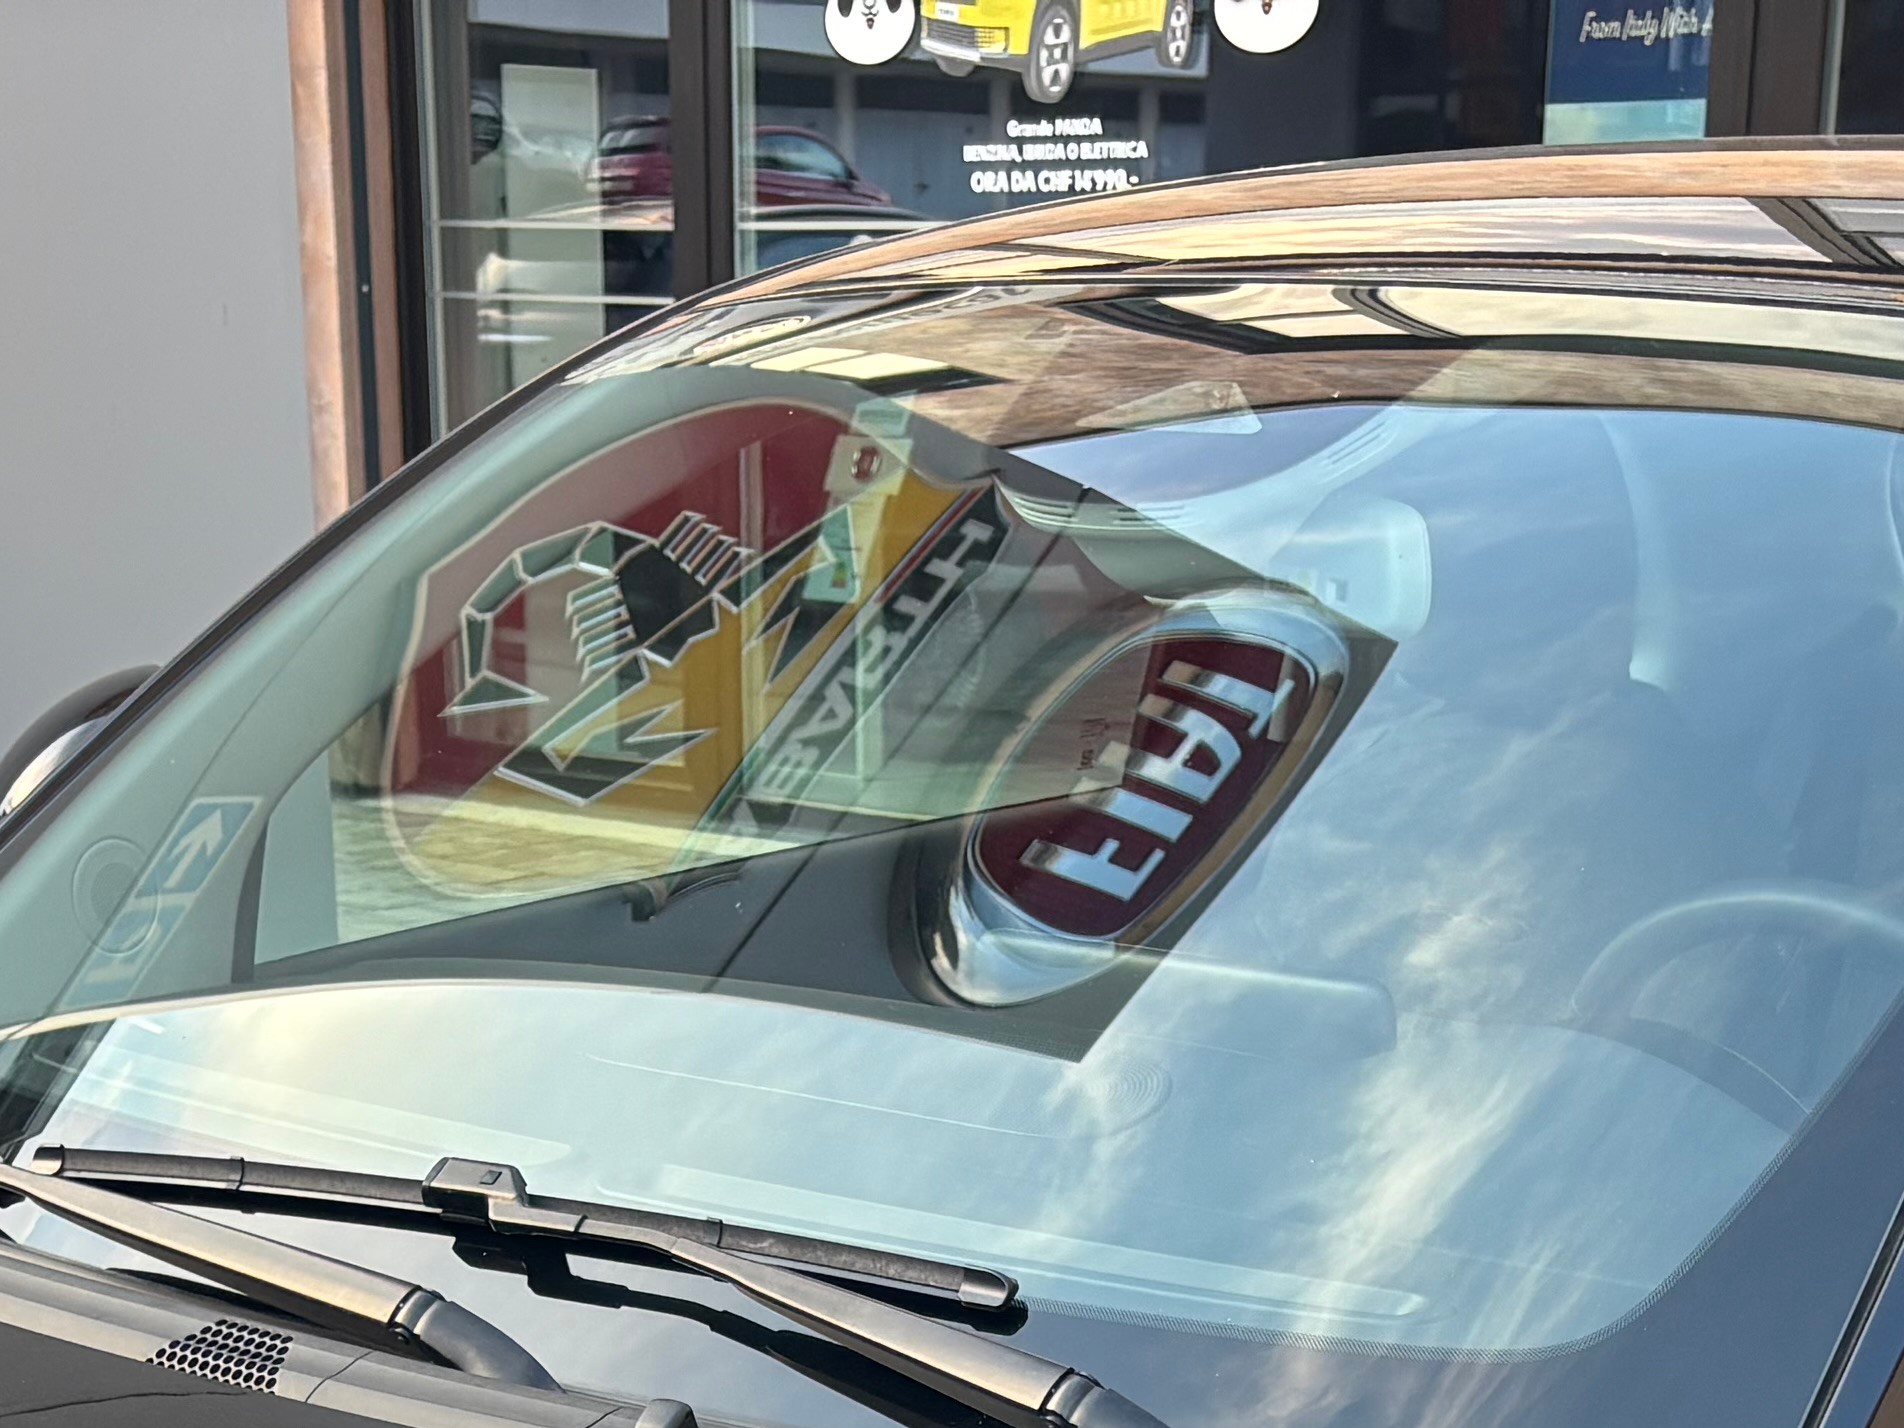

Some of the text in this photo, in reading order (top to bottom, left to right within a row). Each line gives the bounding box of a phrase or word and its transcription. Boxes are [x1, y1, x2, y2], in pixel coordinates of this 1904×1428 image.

[970, 170, 1009, 193] ORA
[1010, 170, 1037, 193] DA
[1037, 169, 1072, 193] CHF
